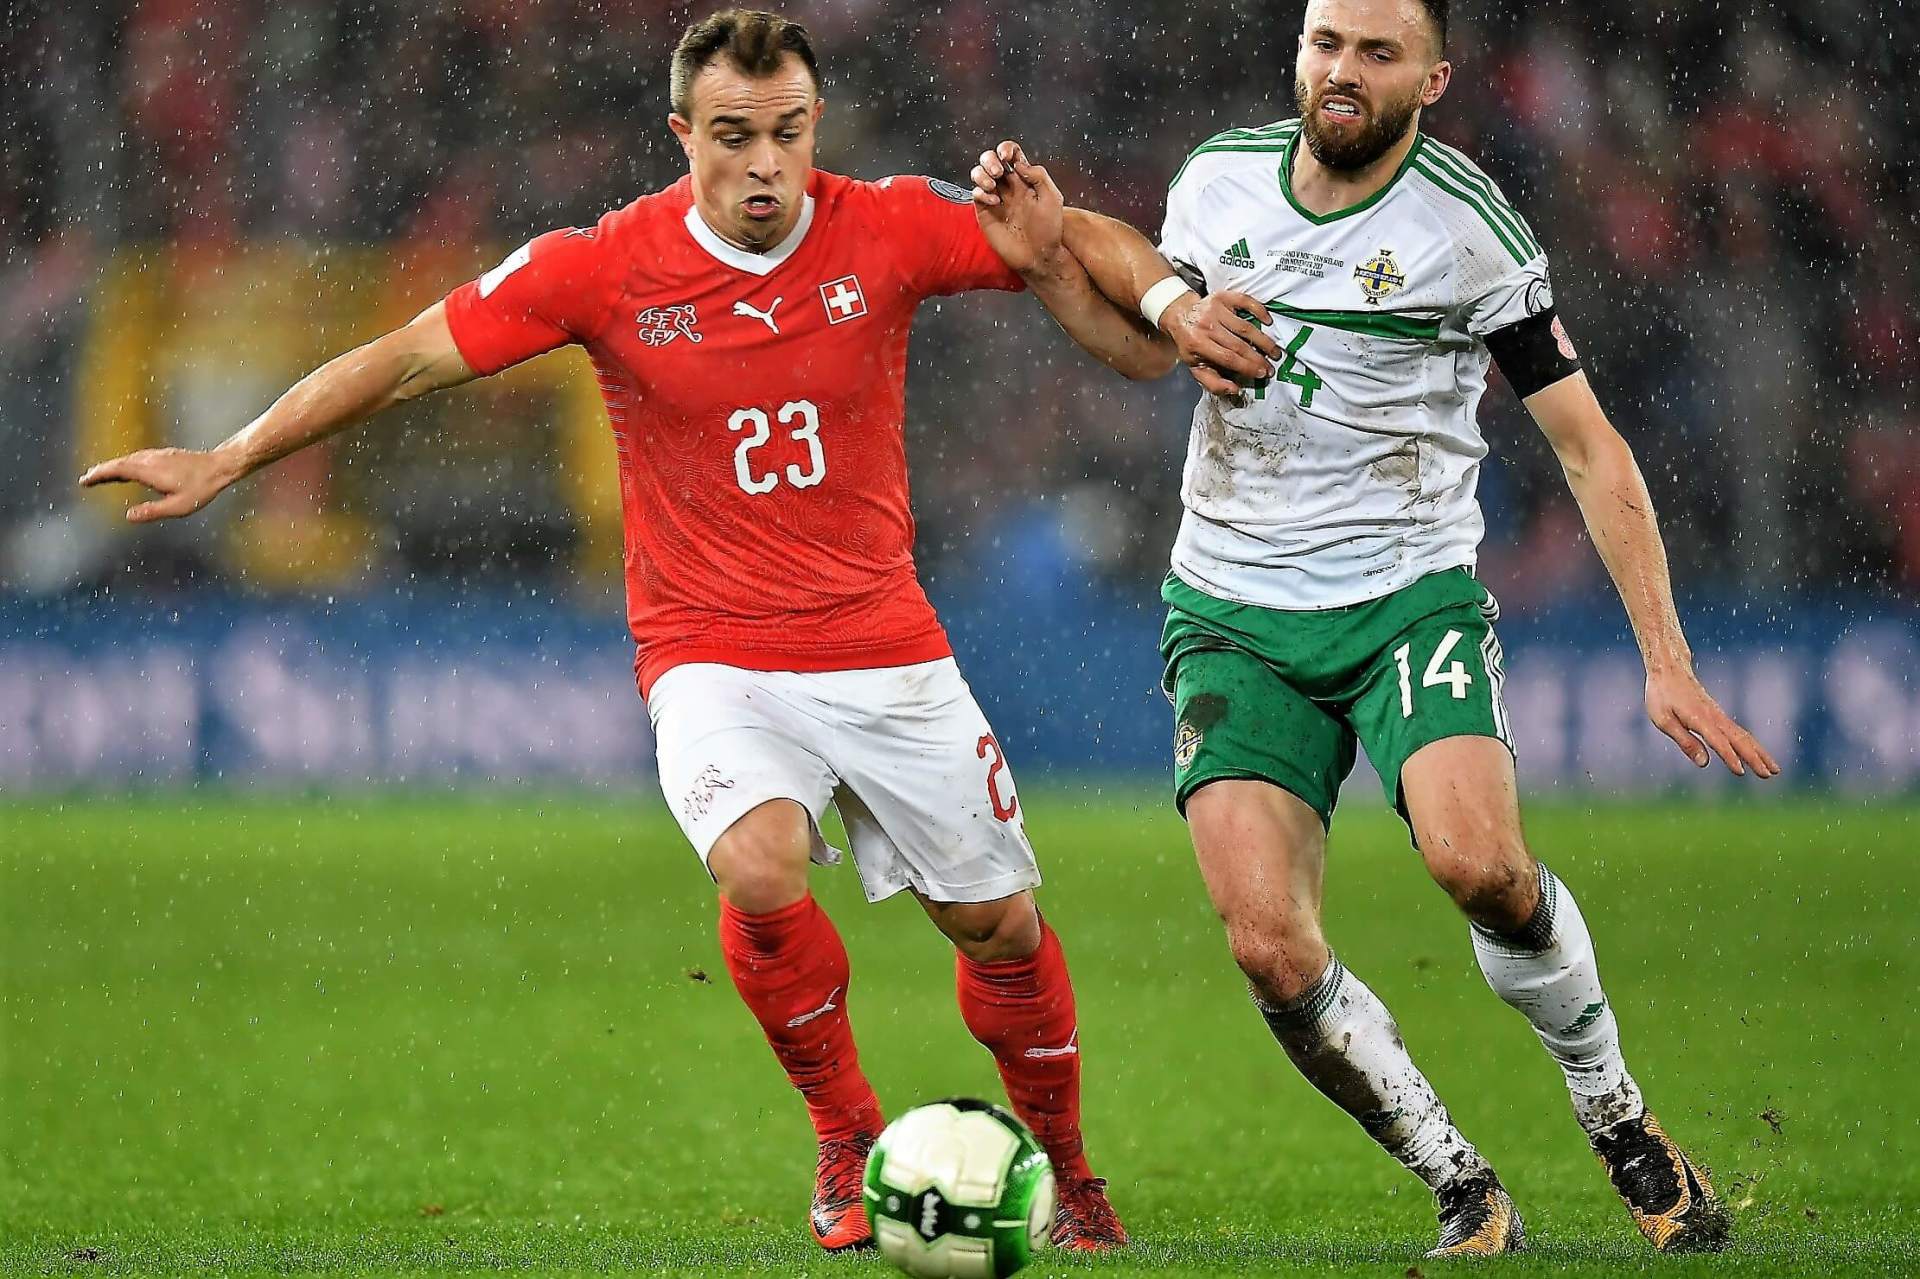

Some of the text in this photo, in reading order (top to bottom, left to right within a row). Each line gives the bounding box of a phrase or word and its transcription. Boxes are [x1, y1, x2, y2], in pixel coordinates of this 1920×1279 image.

[1219, 256, 1255, 269] adidas
[727, 399, 827, 495] 23
[1393, 628, 1473, 719] 14
